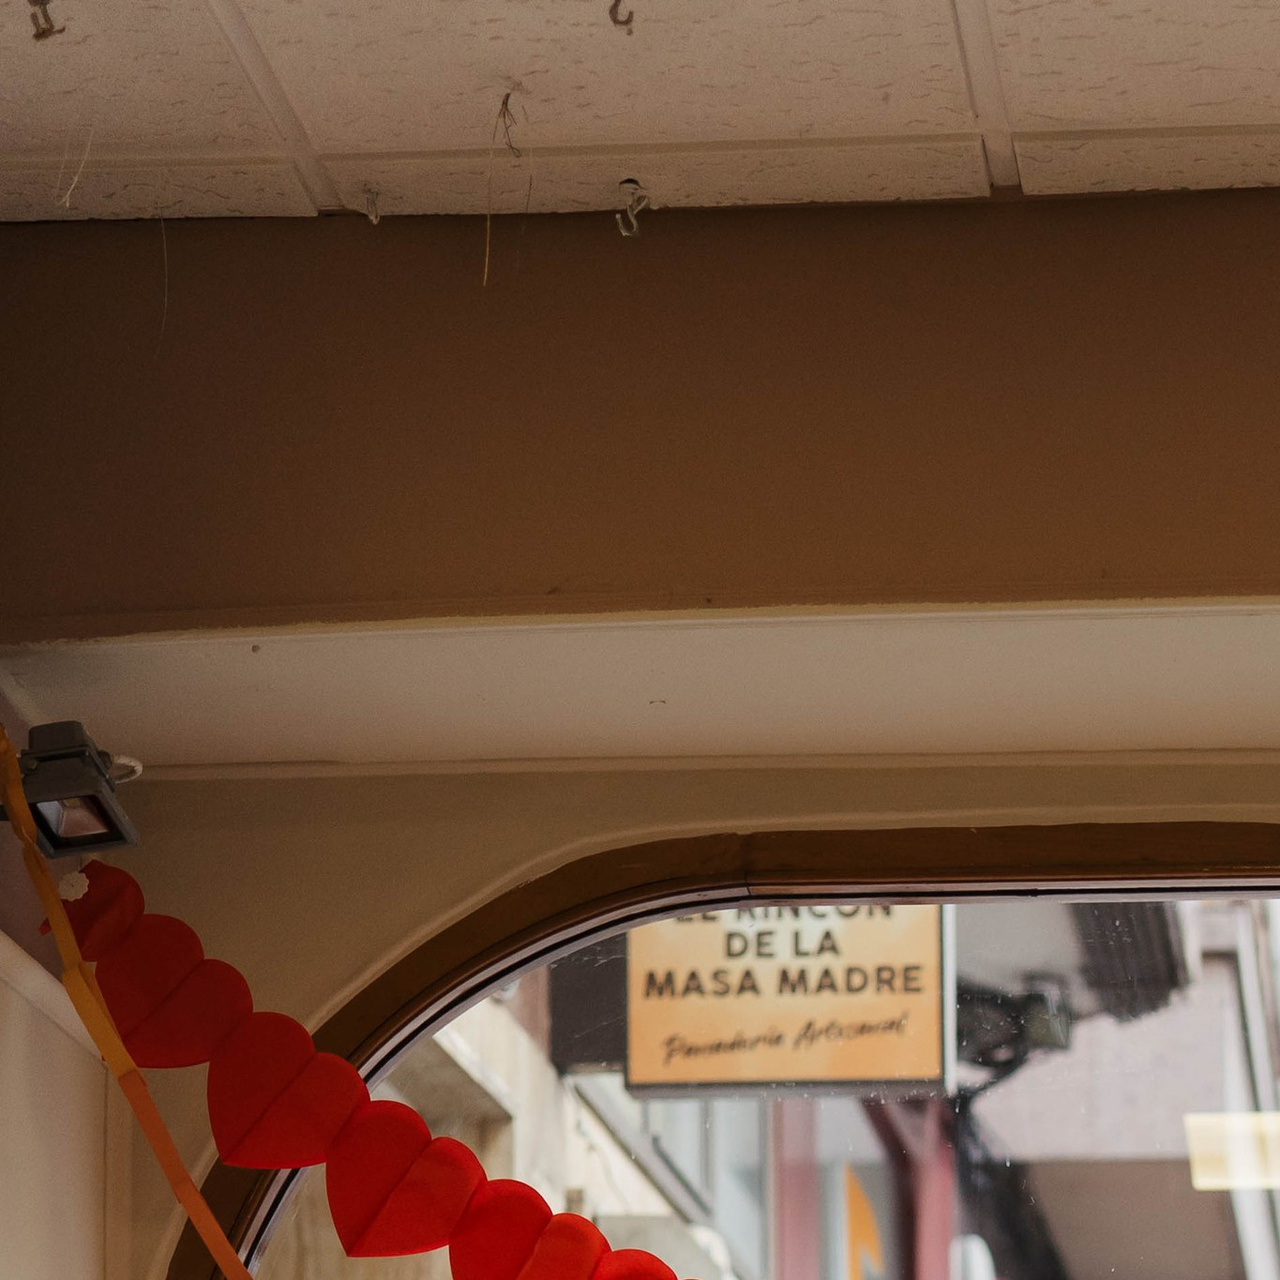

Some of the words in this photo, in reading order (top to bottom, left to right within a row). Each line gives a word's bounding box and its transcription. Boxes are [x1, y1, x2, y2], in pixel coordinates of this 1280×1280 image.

[726, 930, 774, 958] DE
[794, 930, 840, 957] LA
[645, 969, 760, 997] MASA
[778, 965, 922, 995] MADRE
